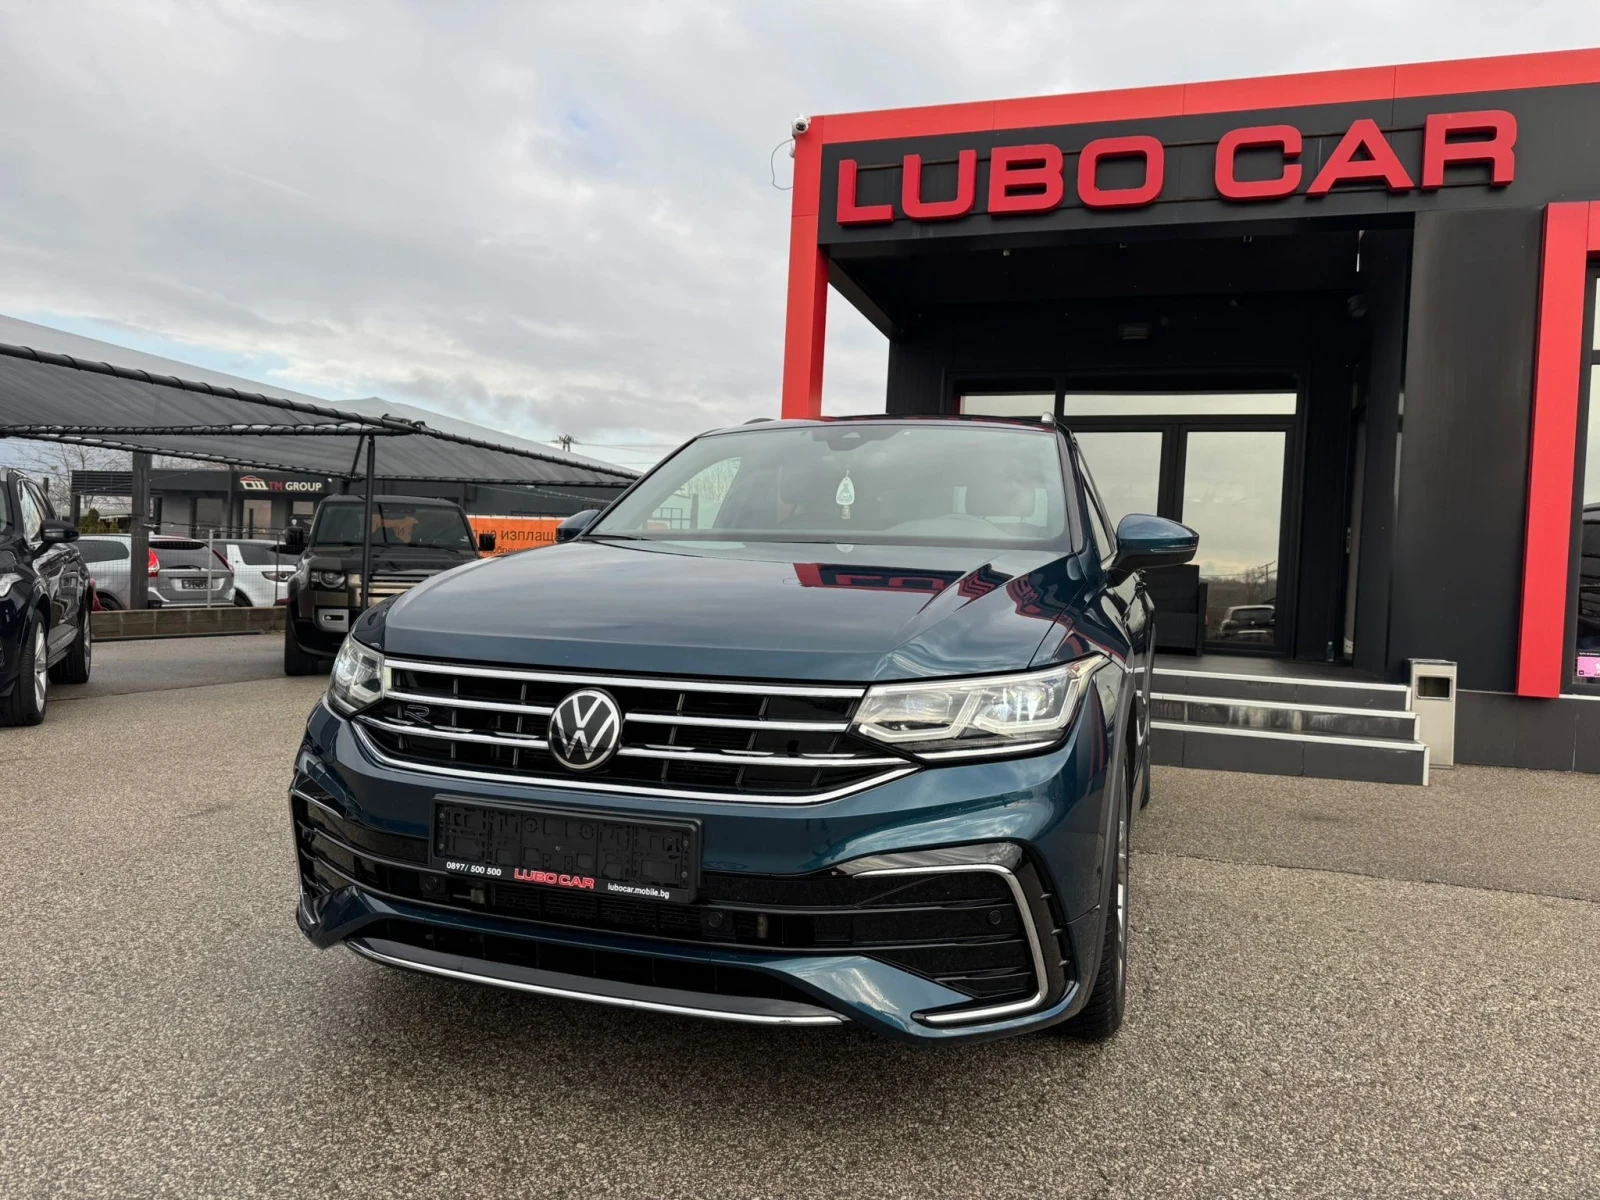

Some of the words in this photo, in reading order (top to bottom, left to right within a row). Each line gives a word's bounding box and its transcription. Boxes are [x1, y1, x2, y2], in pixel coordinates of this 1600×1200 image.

[837, 138, 1165, 224] LUBO
[1215, 110, 1517, 200] CAR
[269, 482, 283, 490] TM
[285, 482, 322, 491] GROUP
[446, 861, 469, 871] 0897/
[470, 865, 485, 874] 500
[486, 867, 502, 876] 500
[514, 868, 556, 884] LUBO
[558, 874, 595, 888] CAR
[608, 882, 670, 899] lubocar.mobile.bg
